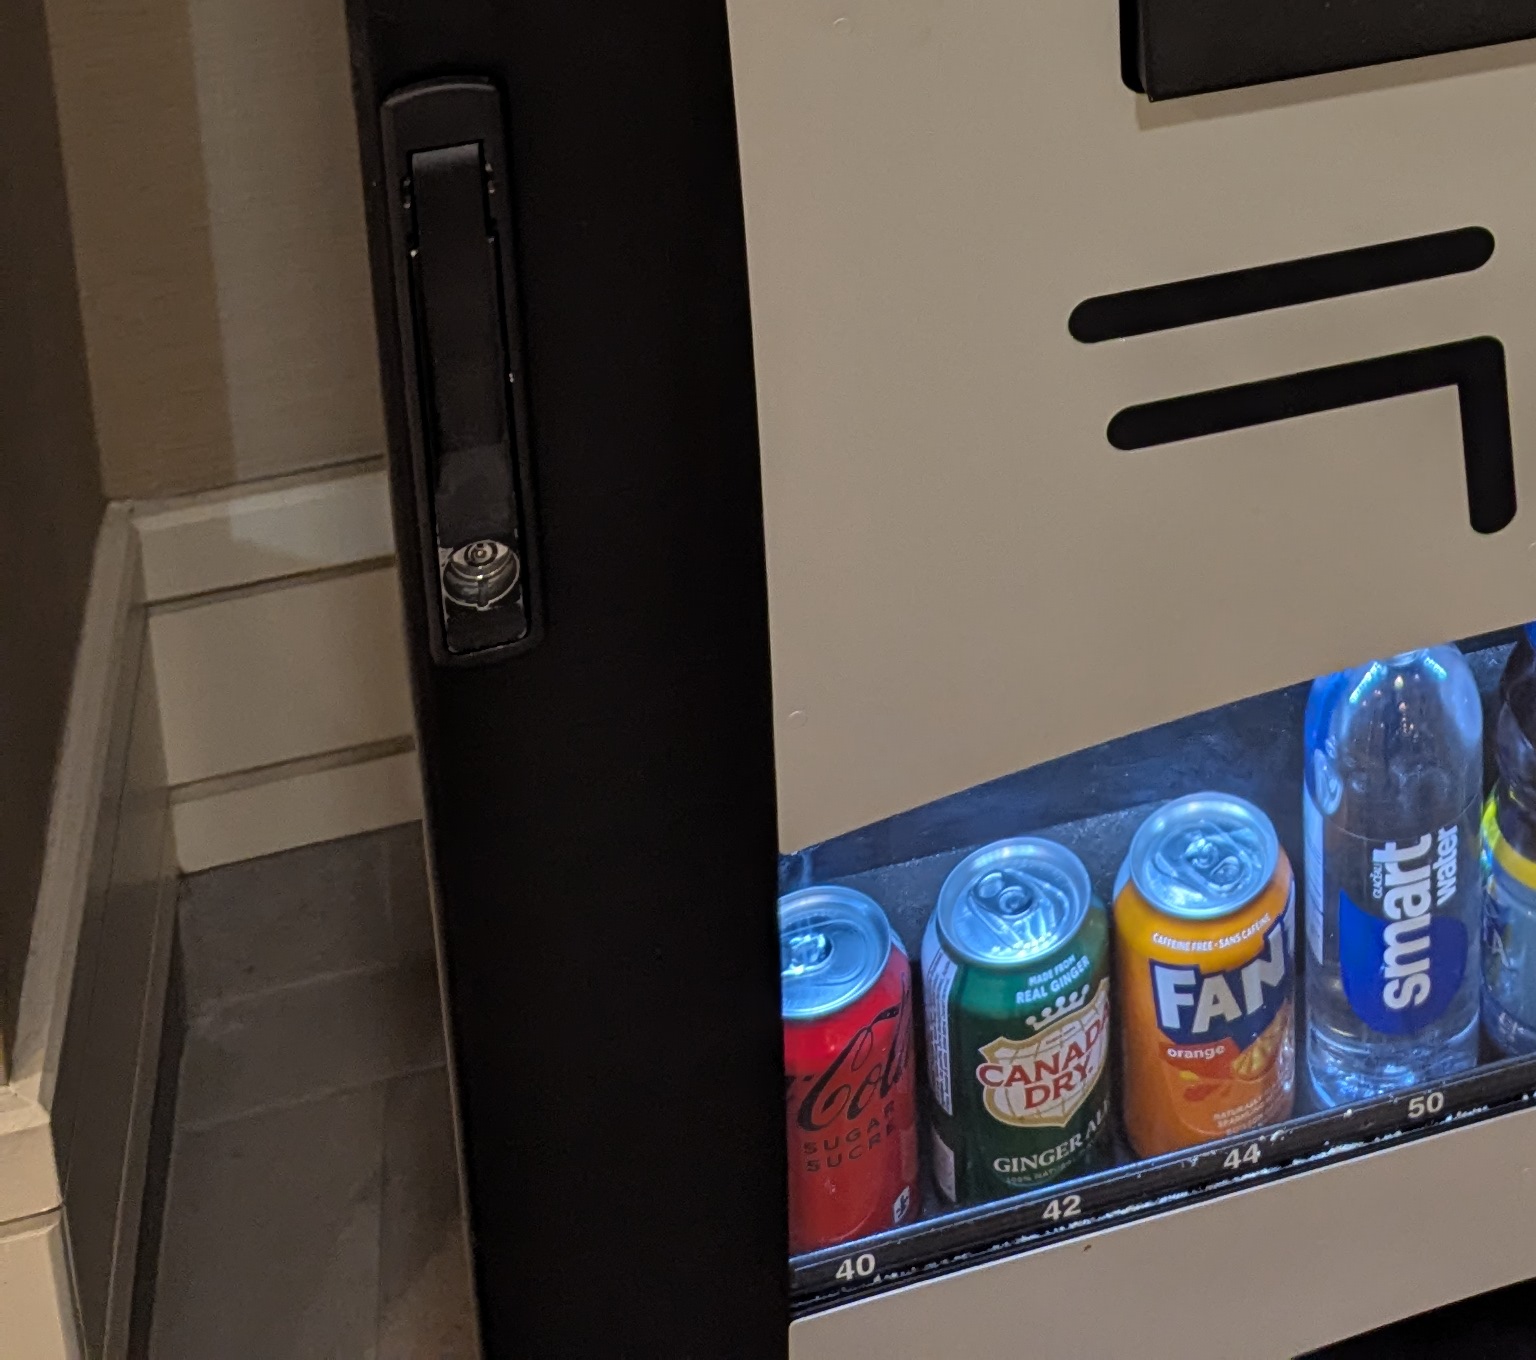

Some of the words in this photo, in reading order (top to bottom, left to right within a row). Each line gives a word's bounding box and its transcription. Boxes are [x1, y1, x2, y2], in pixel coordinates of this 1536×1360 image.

[1433, 824, 1458, 907] water
[1373, 833, 1433, 1010] smart
[1152, 932, 1190, 952] CAFFEINE
[1191, 940, 1213, 952] FREE
[1219, 933, 1241, 949] SANS
[1016, 984, 1048, 1004] REAL
[1050, 954, 1091, 993] GINGER
[1028, 968, 1054, 986] MADE
[1054, 954, 1076, 975] FROM
[1167, 1044, 1226, 1060] orange
[1024, 1056, 1091, 1110] DRY
[1407, 1091, 1445, 1118] 50
[803, 1099, 896, 1155] SUGAR
[993, 1132, 1083, 1173] GINGER
[1223, 1143, 1262, 1170] 44
[1042, 1194, 1082, 1220] 42
[835, 1253, 877, 1281] 40
